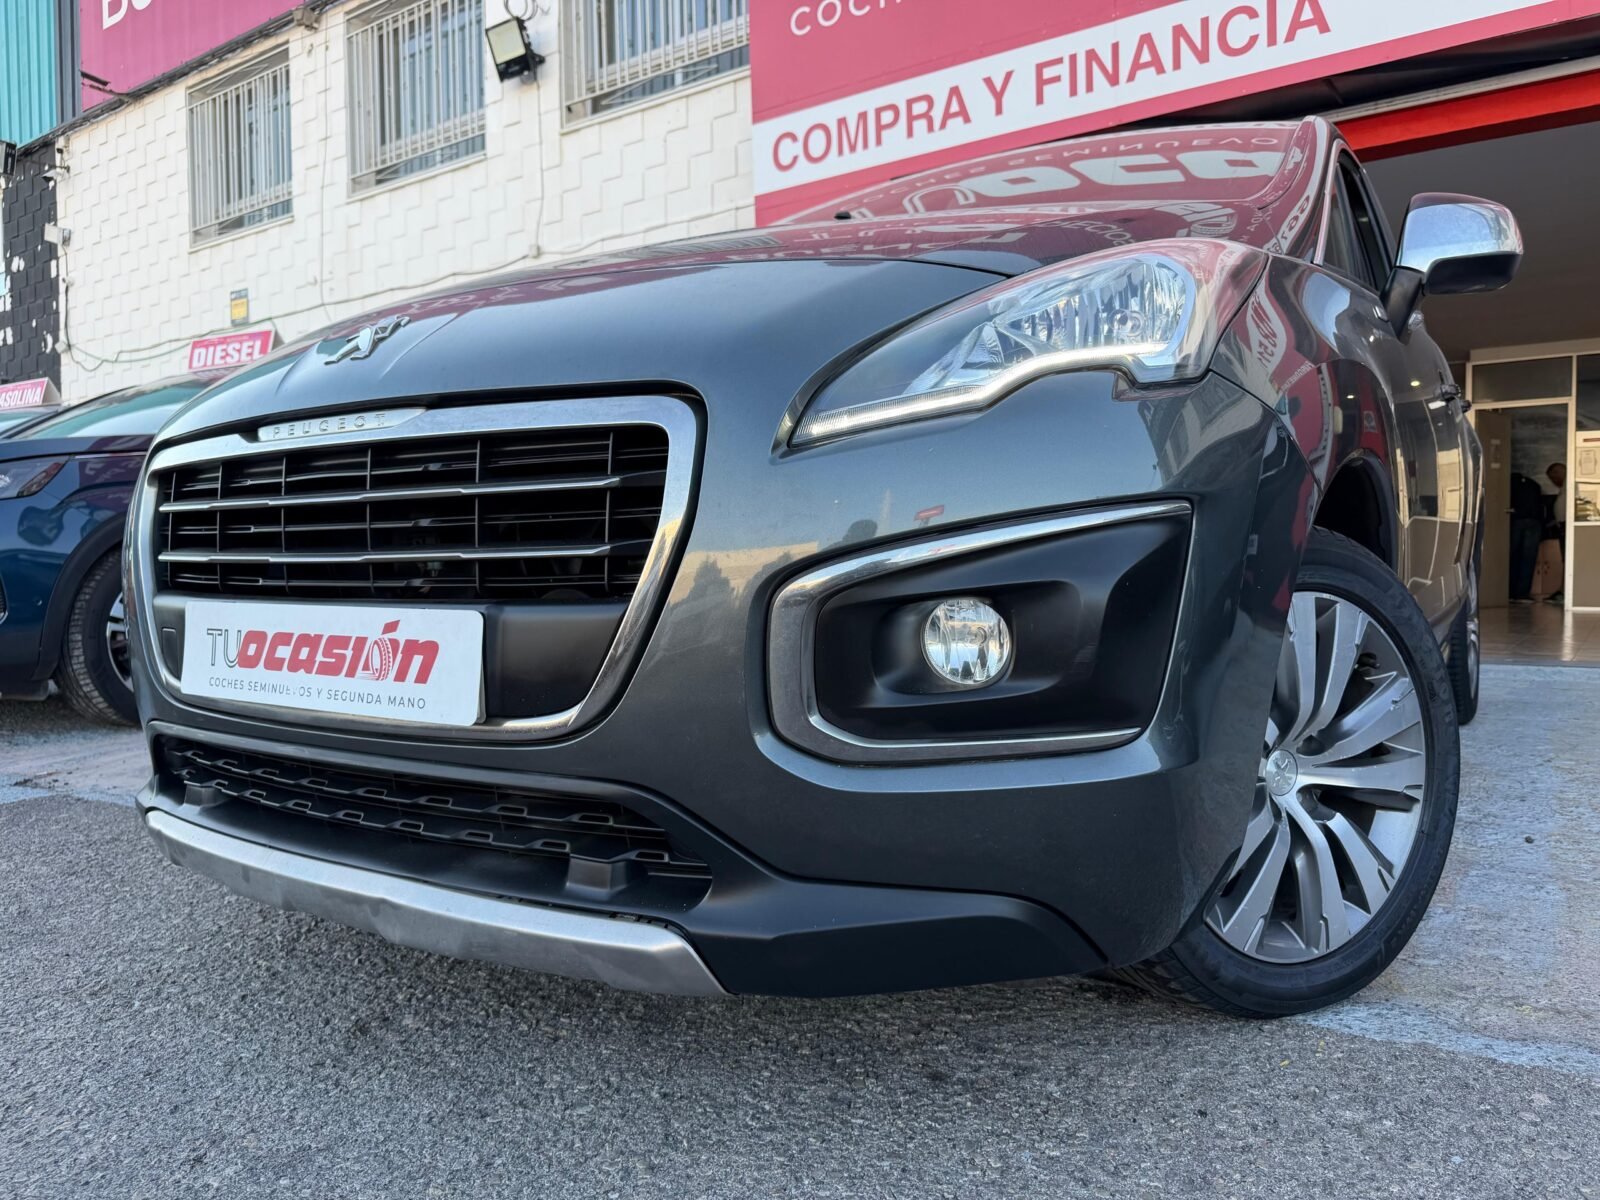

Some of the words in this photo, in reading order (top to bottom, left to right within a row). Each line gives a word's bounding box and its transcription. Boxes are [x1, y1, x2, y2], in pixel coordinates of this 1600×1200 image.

[771, 85, 972, 172] COMPRA
[982, 69, 1015, 117] Y
[1034, 0, 1332, 106] FINANCIA
[191, 339, 264, 368] DIESEL
[272, 412, 387, 439] PEUGEOT
[208, 676, 245, 690] COCHES
[247, 680, 313, 698] SEMINUEOS
[316, 687, 324, 699] Y
[326, 689, 382, 706] SEGUNDA
[387, 695, 427, 710] MANO
